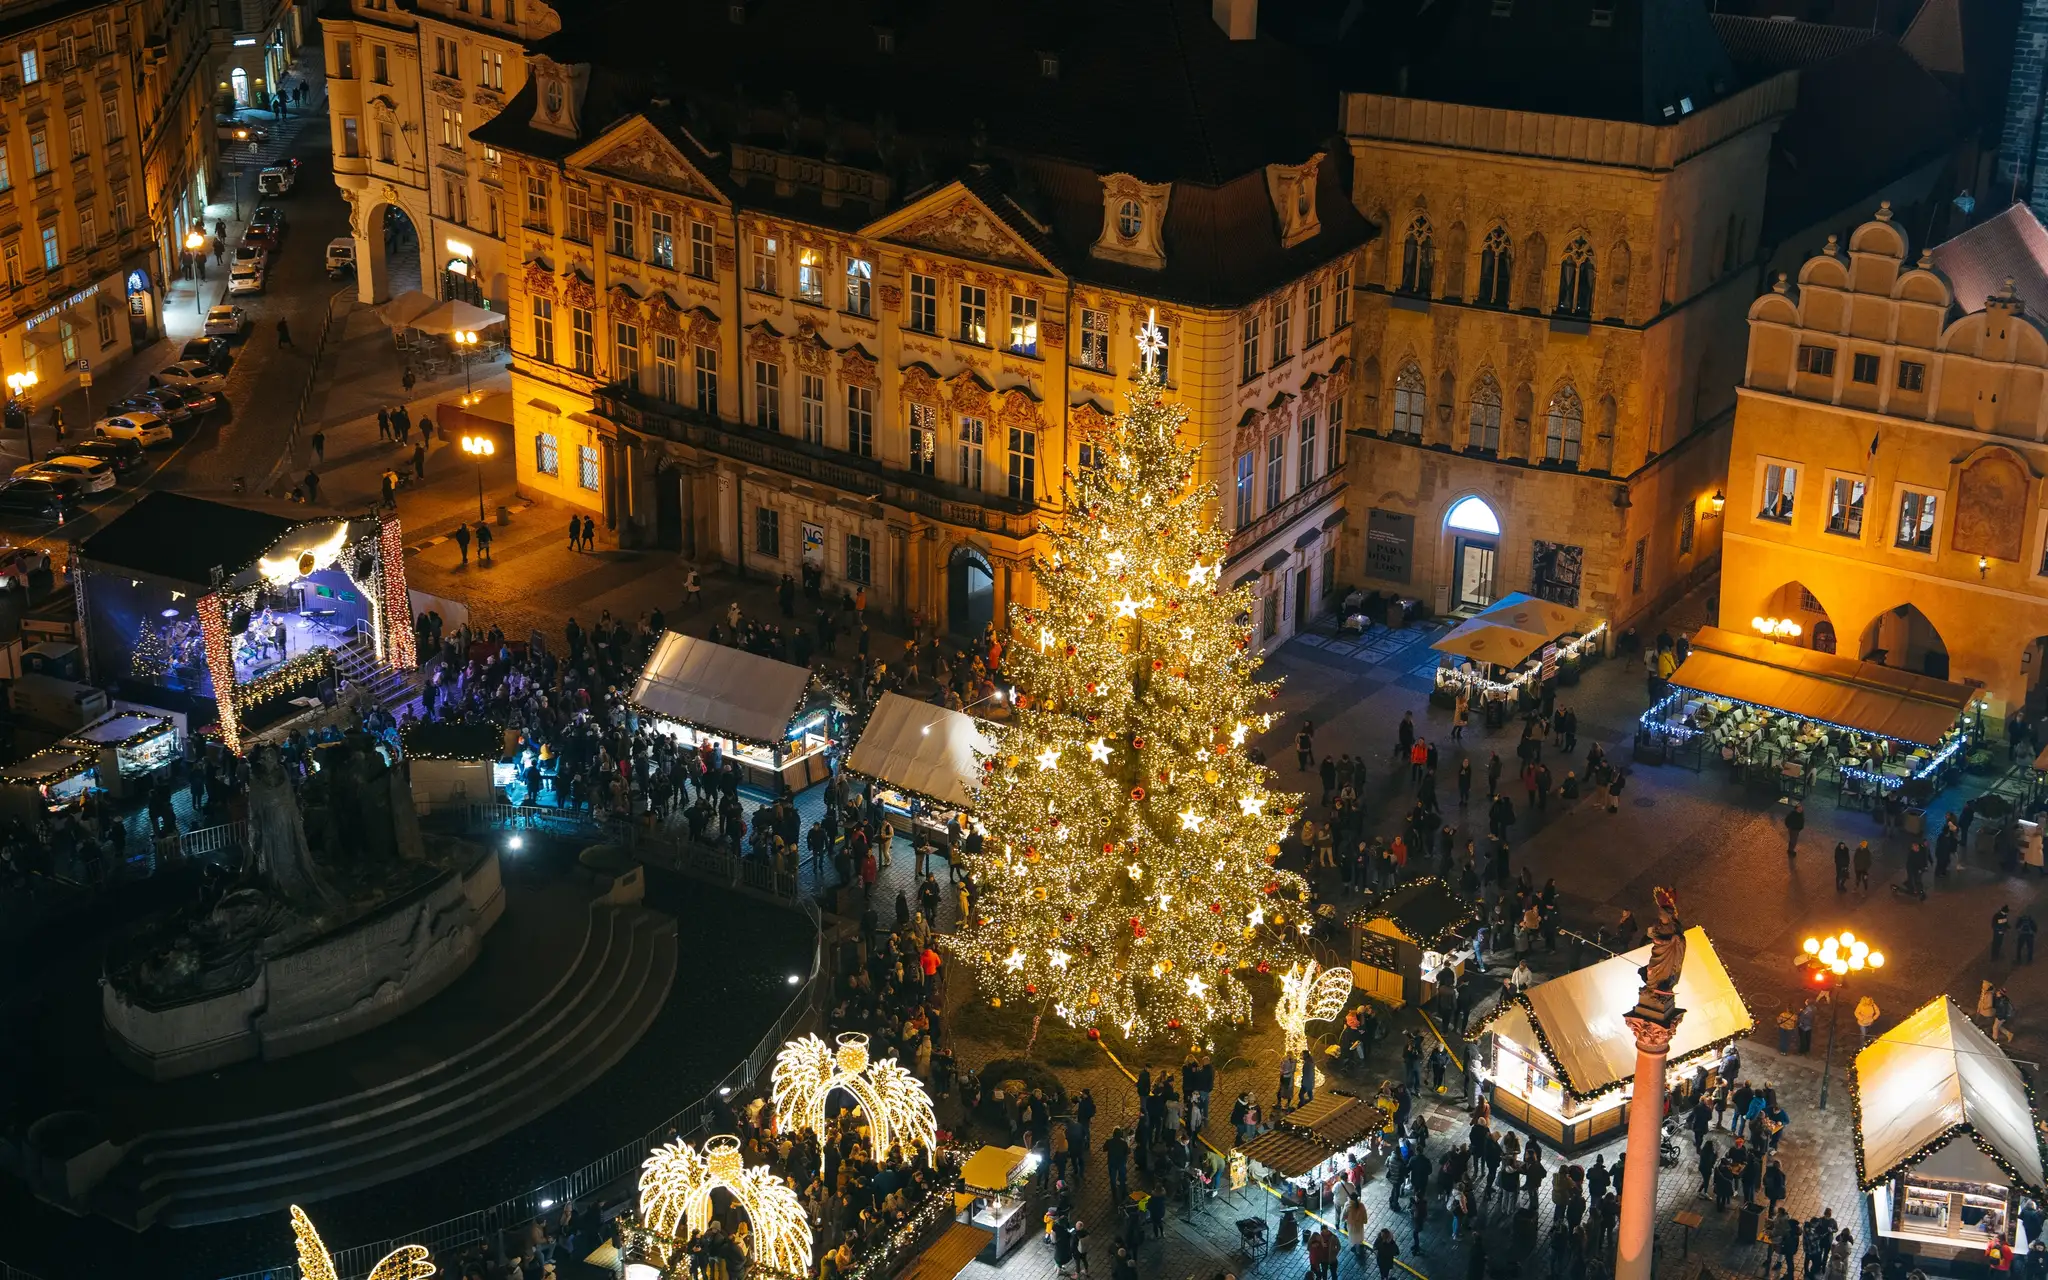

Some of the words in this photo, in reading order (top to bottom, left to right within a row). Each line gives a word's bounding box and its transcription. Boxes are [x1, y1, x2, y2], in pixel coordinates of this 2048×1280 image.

[803, 526, 824, 546] NG
[1376, 543, 1405, 557] PARA
[1375, 562, 1402, 573] LOST
